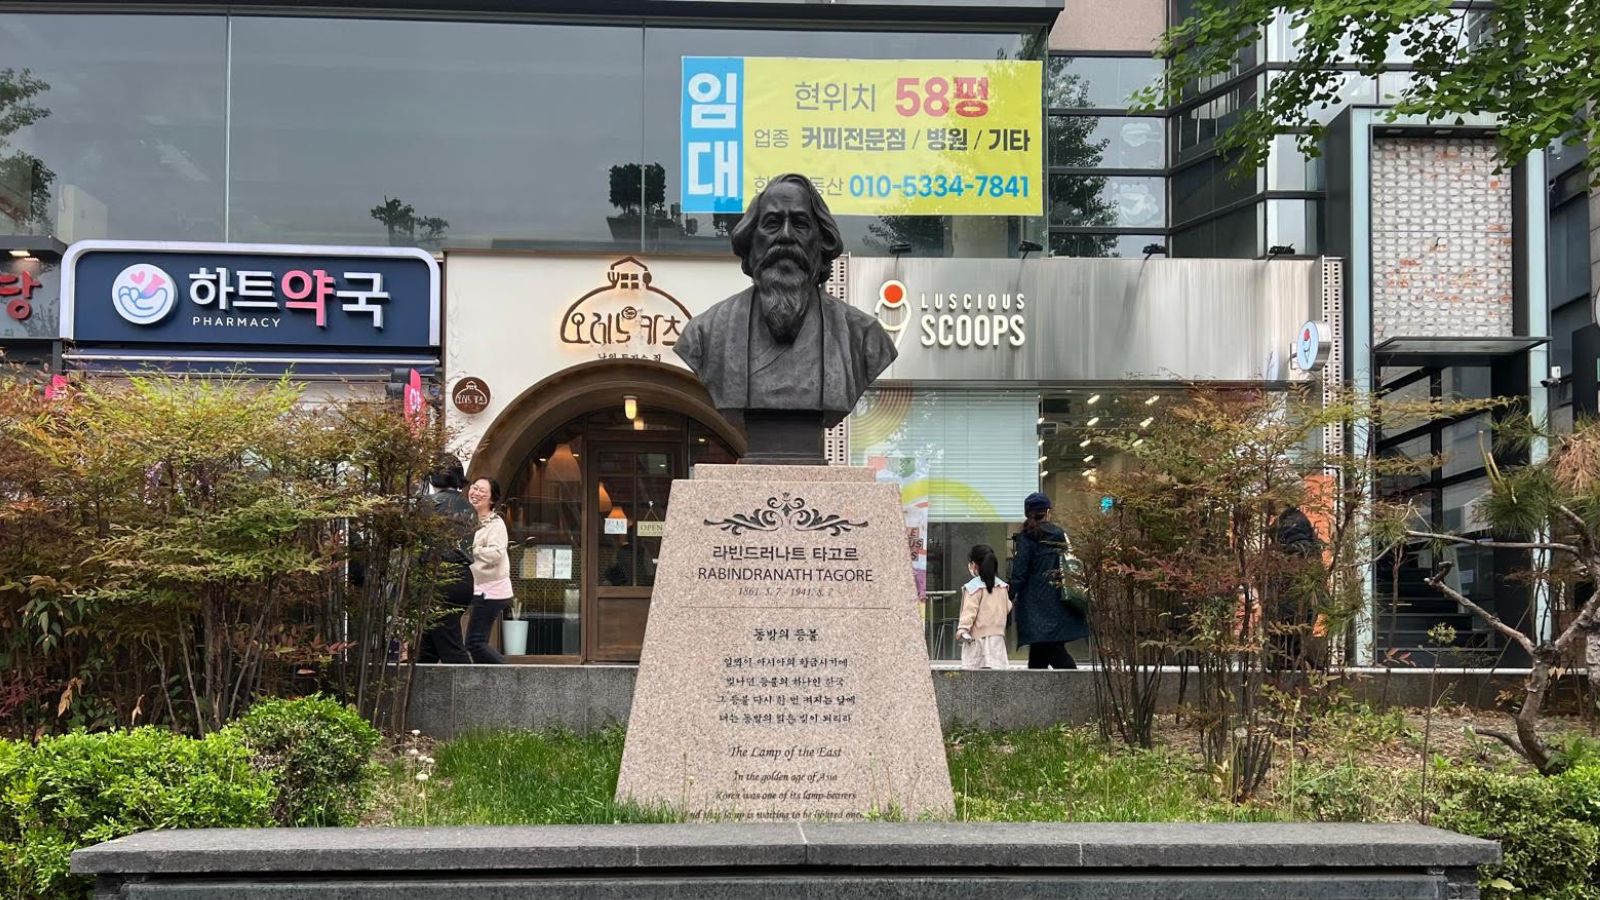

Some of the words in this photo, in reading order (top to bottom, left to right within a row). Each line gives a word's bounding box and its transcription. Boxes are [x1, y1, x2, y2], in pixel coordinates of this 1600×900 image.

[795, 81, 876, 112] 현위치
[895, 76, 990, 118] 58평
[687, 72, 738, 198] 임대
[754, 128, 789, 149] 업종
[801, 127, 906, 152] 커피전문점
[926, 127, 968, 152] 병원
[989, 128, 1031, 152] 기타
[849, 174, 1029, 198] 010-5334-7841
[189, 267, 390, 328] 하트약국
[920, 293, 1025, 310] LUSCIOUS
[192, 316, 281, 328] PHARMACY
[920, 314, 1026, 347] SCOOPS
[713, 545, 806, 562] 라빈드러나트
[812, 546, 859, 562] 타고르
[698, 567, 813, 582] RABINDRANATH
[816, 567, 873, 583] TAGORE
[753, 628, 789, 642] 동방의
[794, 628, 818, 642] 등불
[724, 657, 752, 669] 일찍이
[756, 657, 795, 668] 아시아의
[799, 657, 848, 669] 황금시기에
[726, 676, 755, 688] 빛나던
[792, 676, 821, 687] 하나인
[730, 694, 750, 706] 등불
[753, 694, 772, 705] 다시
[803, 694, 833, 706] 켜지는
[836, 694, 856, 706] 날에
[742, 713, 772, 724] 동방의
[800, 713, 818, 724] 빛이
[822, 713, 851, 724] 되리라
[728, 746, 748, 757] The
[751, 746, 782, 760] Lamp
[784, 745, 798, 761] of
[798, 746, 815, 757] the
[817, 746, 842, 757] East
[733, 770, 744, 781] In
[746, 771, 760, 781] the
[761, 770, 788, 783] golden
[790, 774, 805, 783] age
[807, 771, 819, 783] of
[817, 773, 838, 782] Asia
[715, 790, 741, 799] Korea
[778, 790, 788, 802] of
[790, 791, 801, 799] its
[803, 790, 857, 802] lamp-bearers
[791, 810, 801, 819] to
